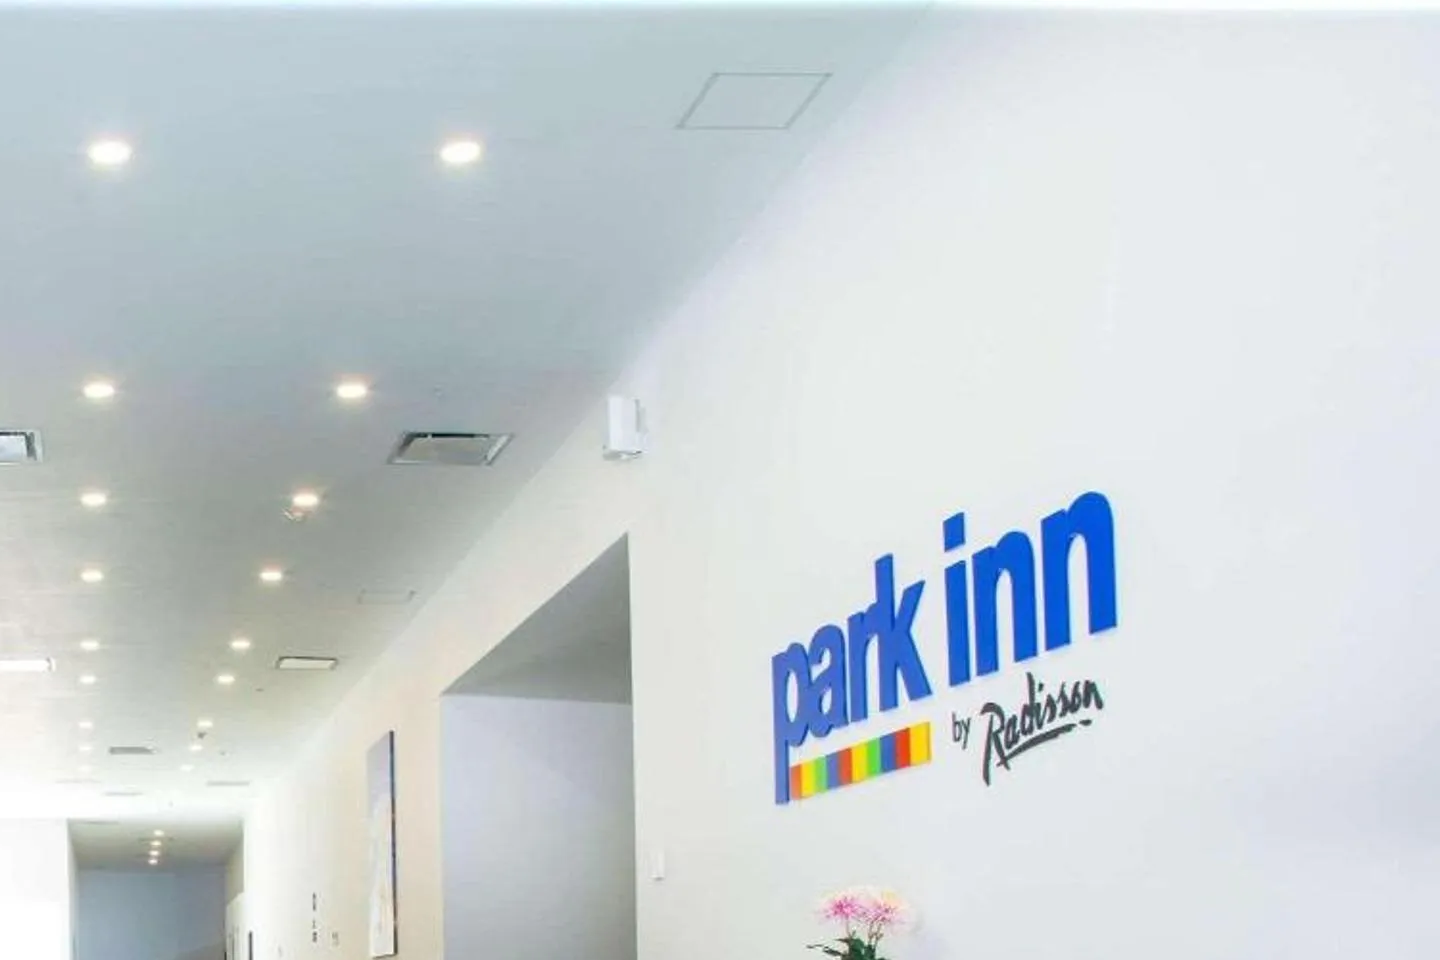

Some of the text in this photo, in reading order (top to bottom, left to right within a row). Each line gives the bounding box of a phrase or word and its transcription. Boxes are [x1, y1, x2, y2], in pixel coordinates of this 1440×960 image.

[772, 491, 1117, 805] park inn
[951, 671, 1104, 786] by Radisson
